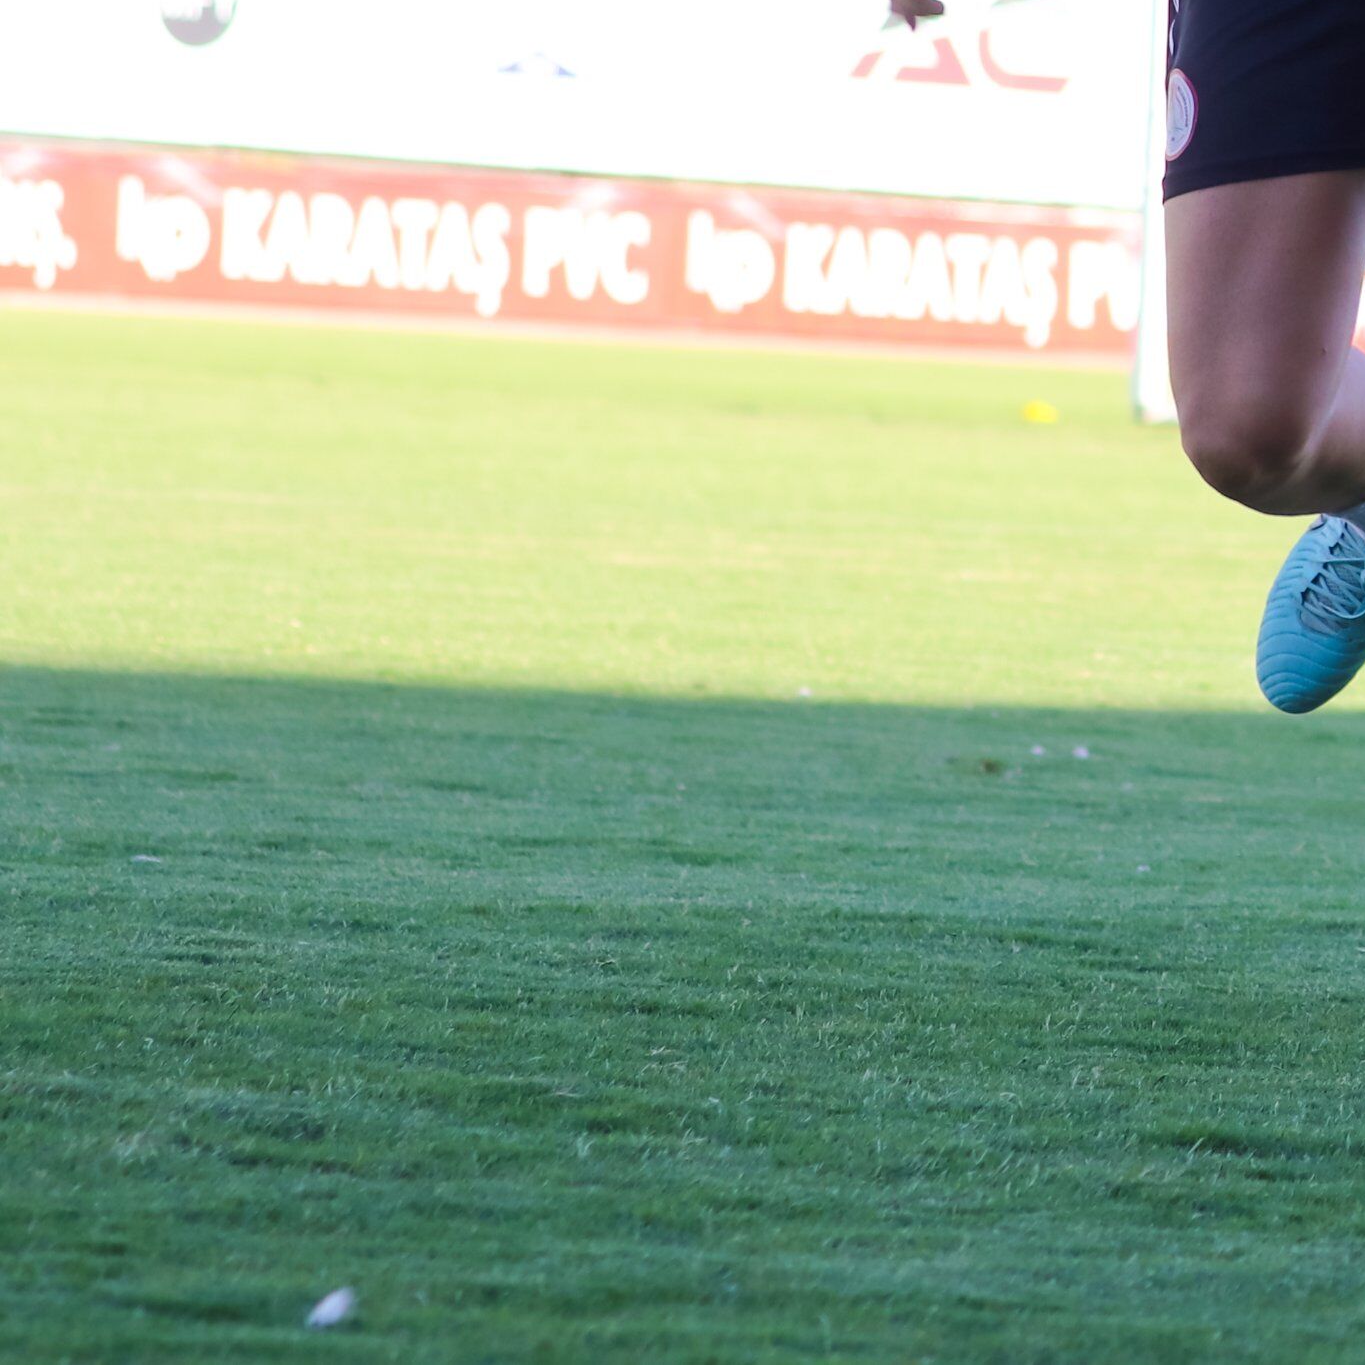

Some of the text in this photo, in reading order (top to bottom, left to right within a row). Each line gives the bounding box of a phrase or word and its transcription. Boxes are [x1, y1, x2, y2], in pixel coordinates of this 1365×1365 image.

[219, 186, 511, 318] KARATAŞ
[521, 205, 652, 305] PVC
[783, 222, 1058, 348] KARATAŞ
[1066, 239, 1142, 333] PV
